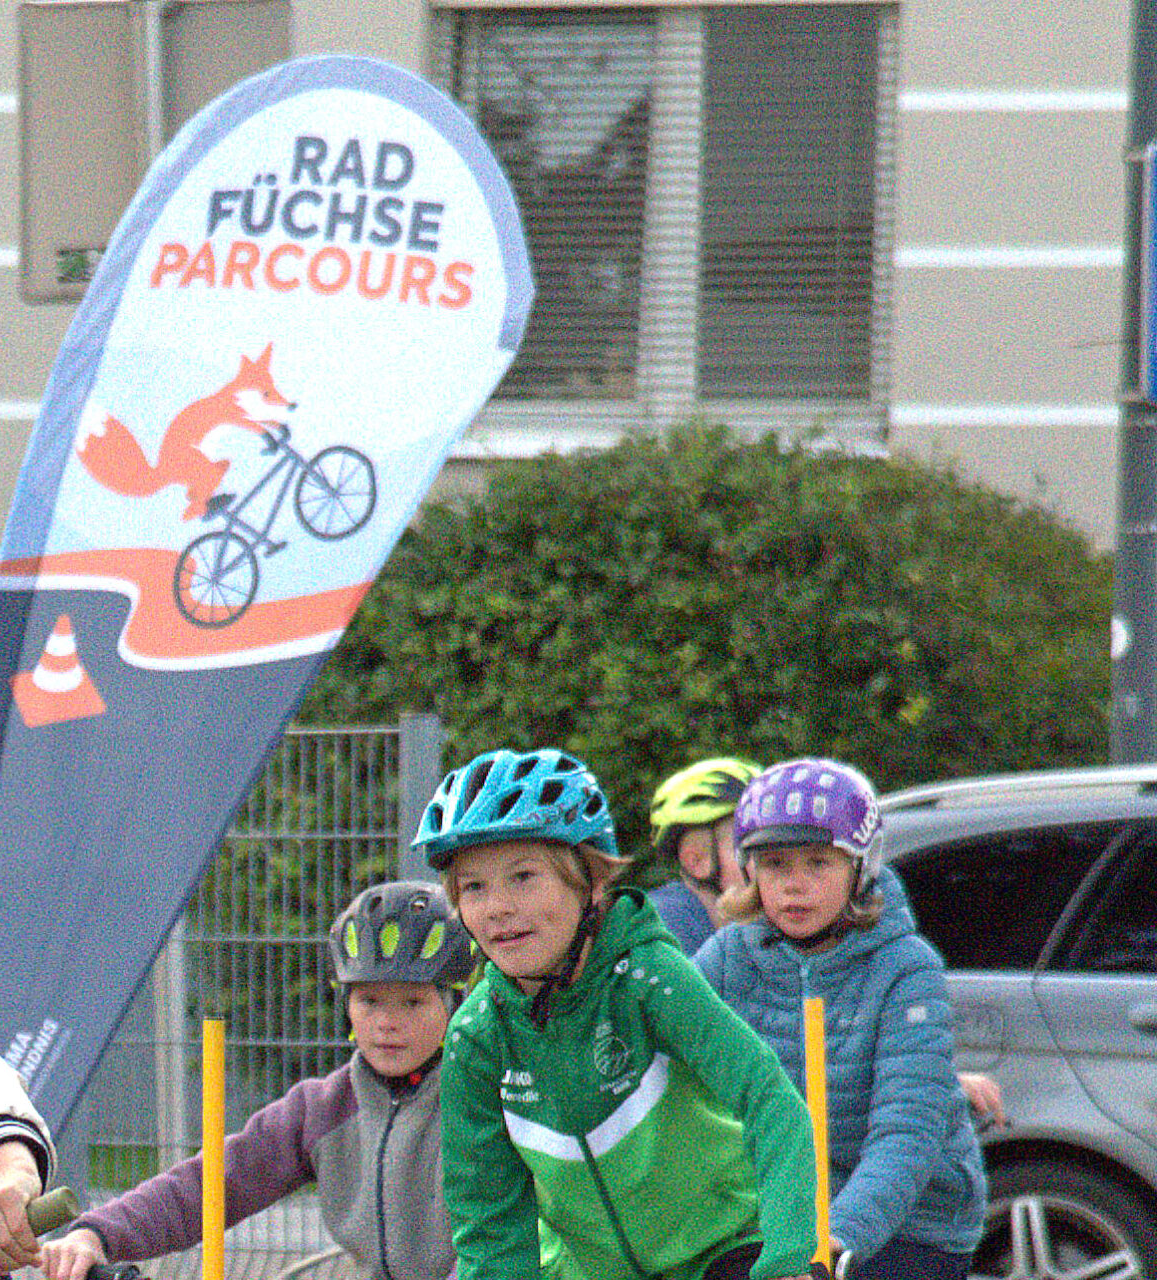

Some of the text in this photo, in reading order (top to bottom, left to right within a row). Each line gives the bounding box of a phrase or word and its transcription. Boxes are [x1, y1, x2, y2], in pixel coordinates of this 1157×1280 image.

[291, 135, 415, 192] RAD
[207, 173, 445, 252] FÜCHSE
[149, 240, 476, 310] PARCOURS
[4, 1032, 33, 1067] MA
